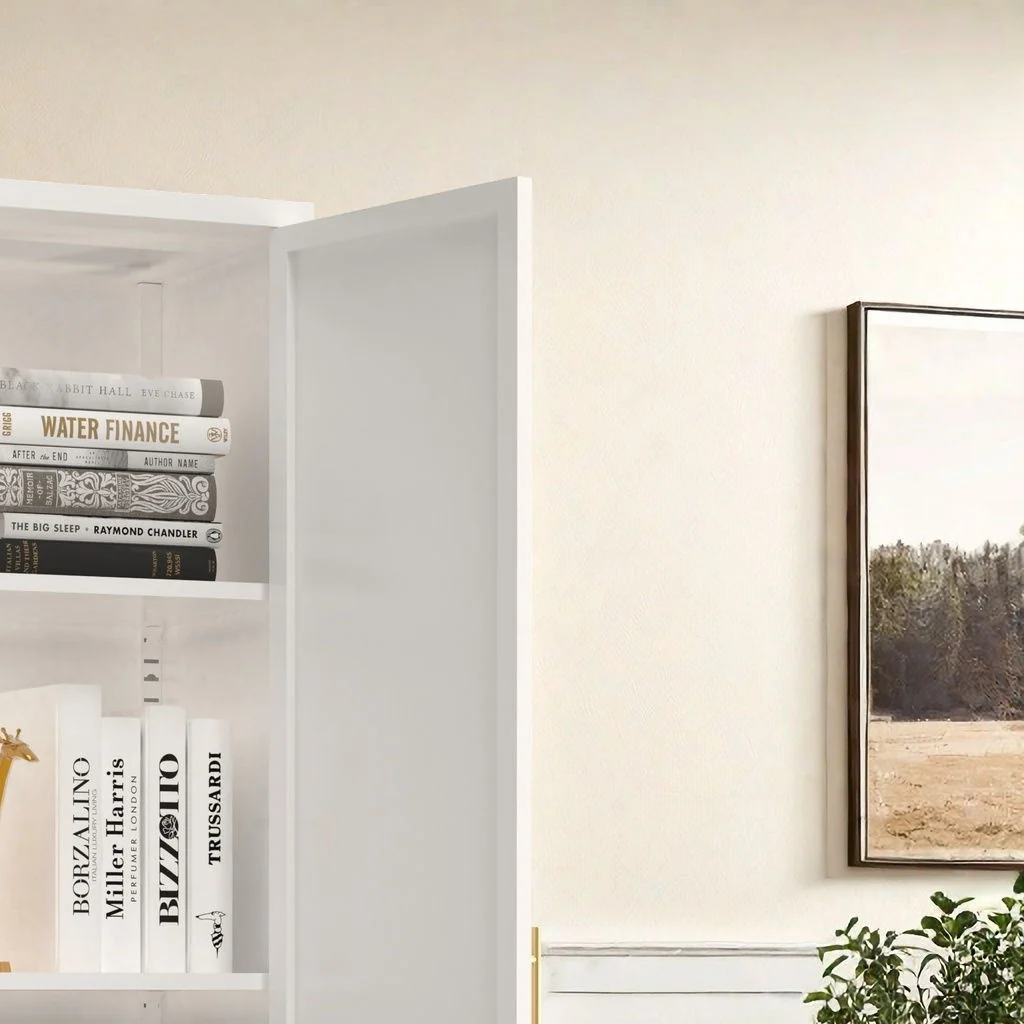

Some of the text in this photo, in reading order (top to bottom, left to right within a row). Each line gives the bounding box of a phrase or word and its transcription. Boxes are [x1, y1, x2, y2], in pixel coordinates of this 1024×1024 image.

[48, 383, 93, 395] ABBIT
[99, 386, 132, 397] HALL
[141, 388, 196, 399] EVE CHASE
[2, 412, 12, 437] GRIGG
[41, 415, 180, 444] WATER FINANCE
[12, 450, 36, 460] AFTER
[52, 452, 68, 461] END
[144, 457, 199, 469] AUTHOR NAME
[26, 472, 34, 505] MEMOIR
[46, 475, 54, 506] BALZAC
[12, 521, 81, 533] THE BIG SLEEP
[94, 526, 198, 538] RAYMOND CHANDLER
[208, 752, 222, 866] TRUSSARDI
[73, 757, 91, 916] BORZALINO
[106, 758, 124, 919] Miller Harris
